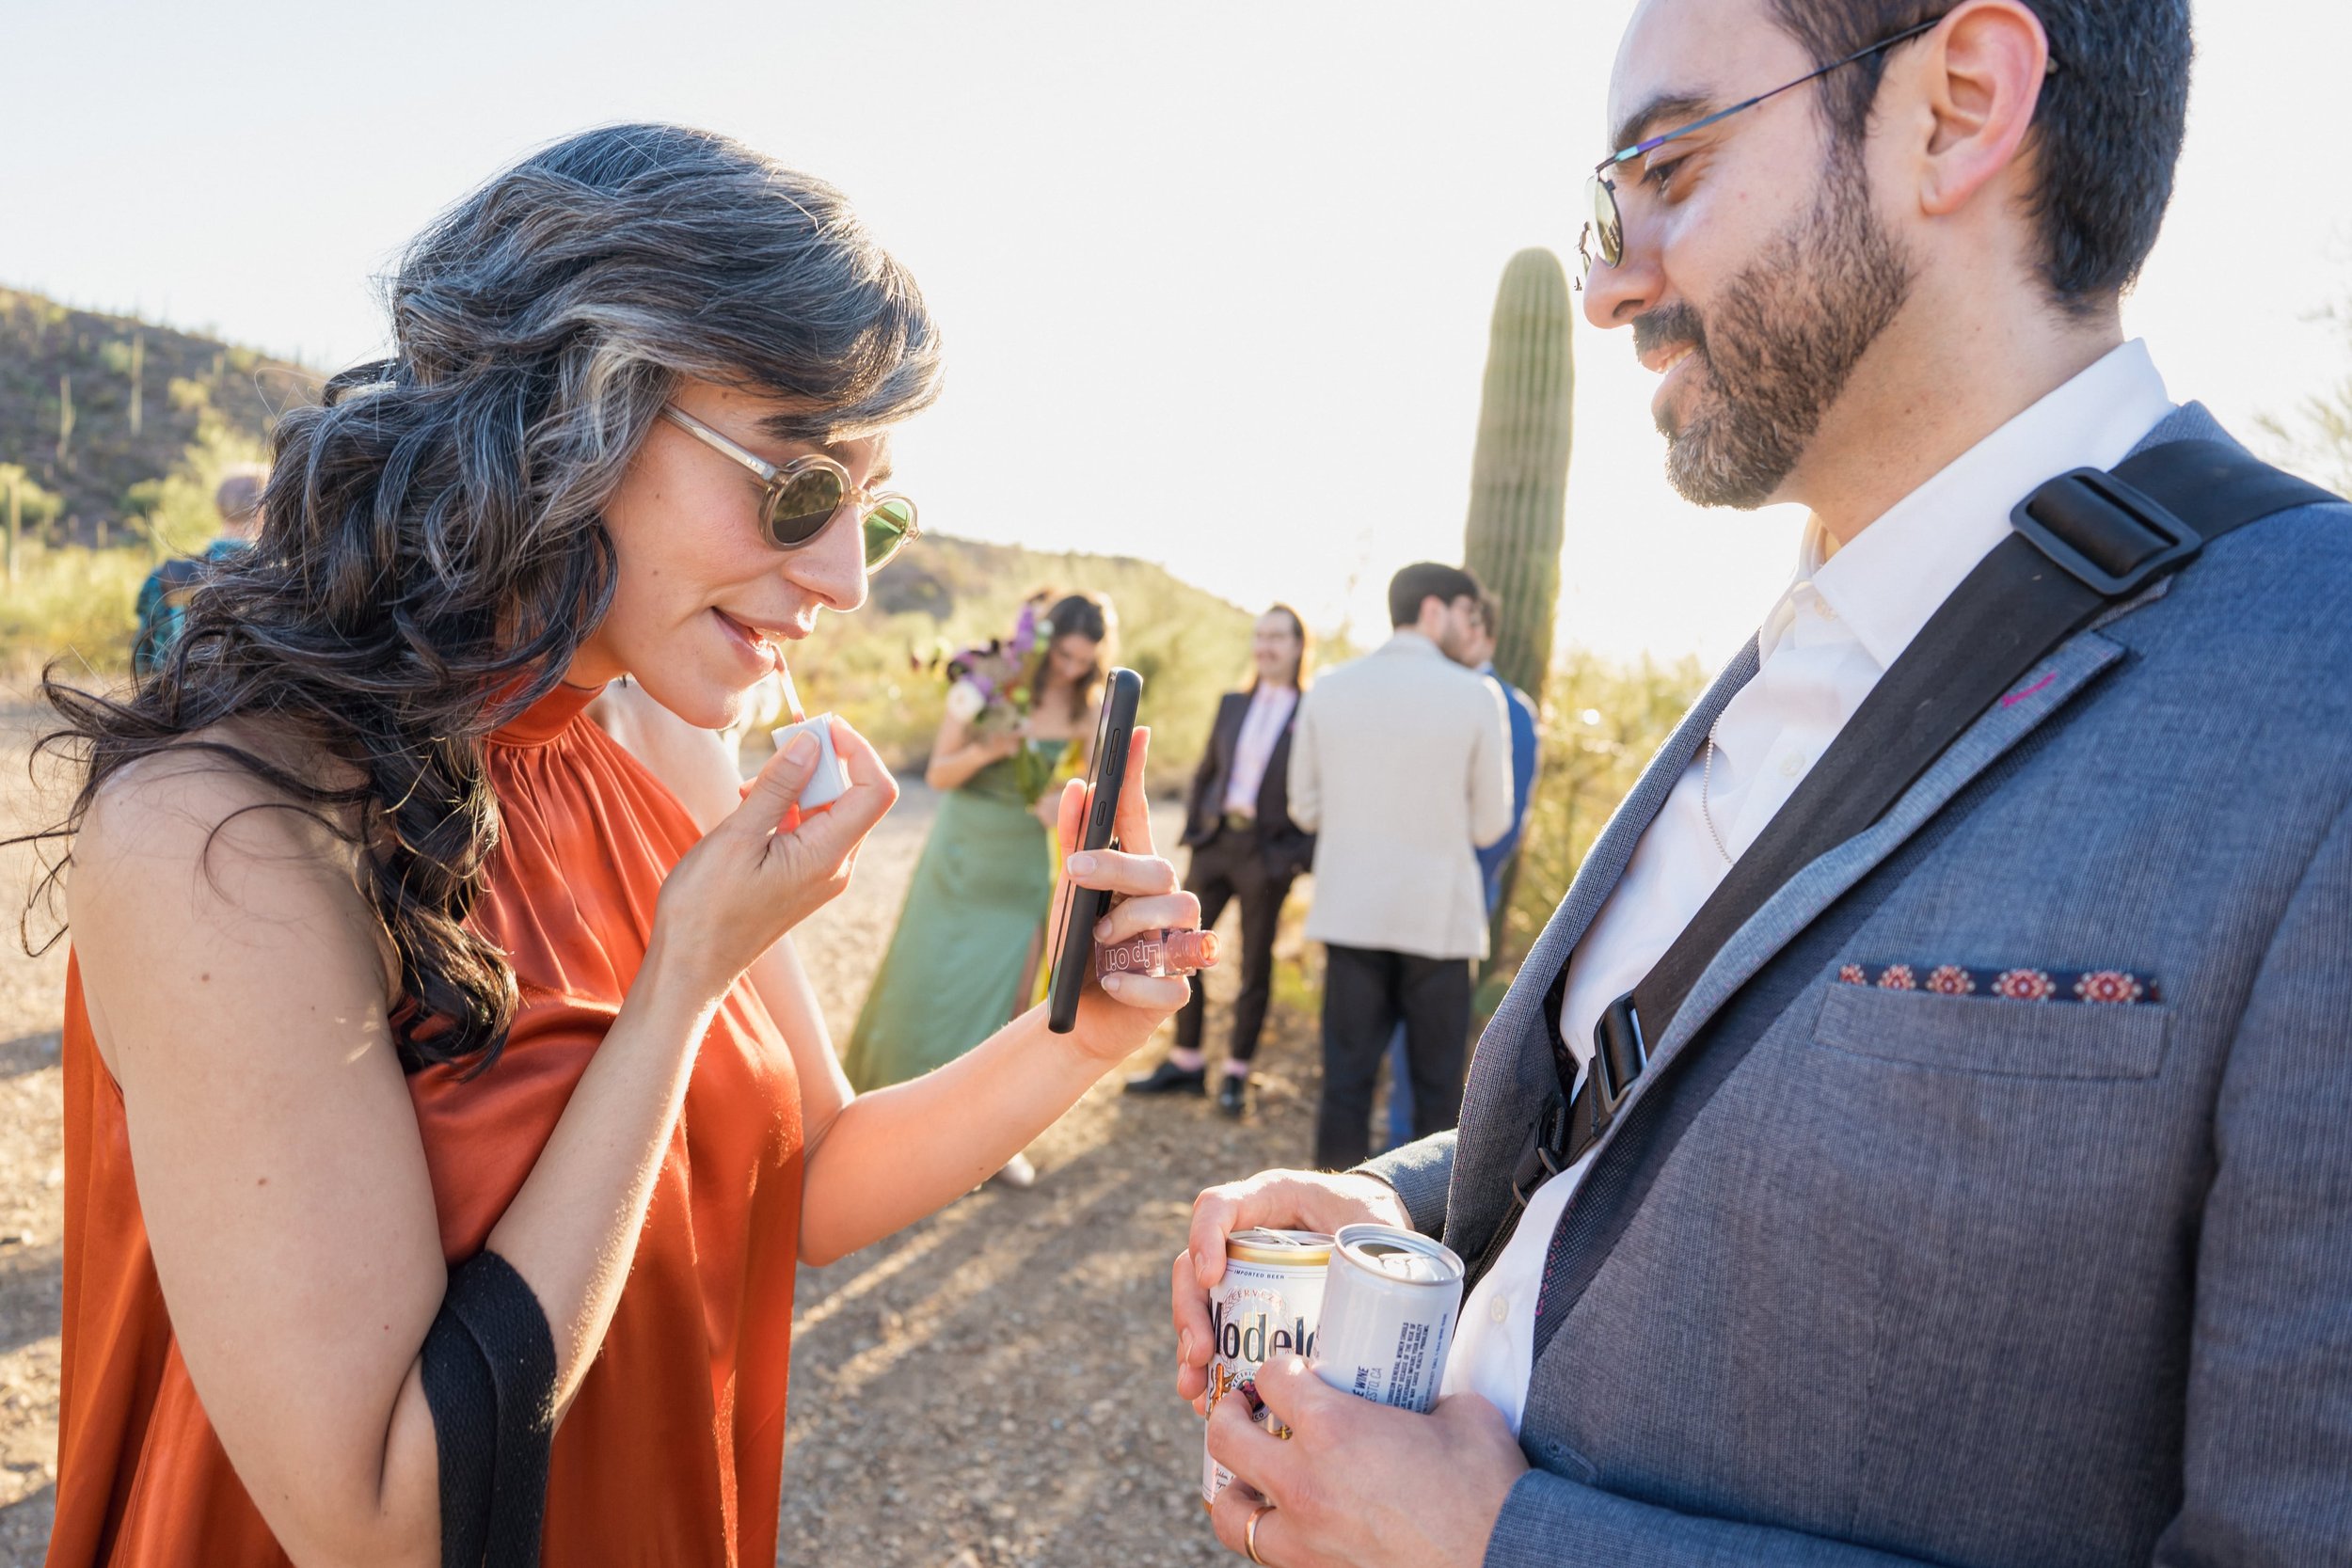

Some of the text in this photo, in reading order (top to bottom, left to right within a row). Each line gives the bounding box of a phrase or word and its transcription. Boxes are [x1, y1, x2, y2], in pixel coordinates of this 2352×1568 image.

[1104, 940, 1162, 972] Lip Oil
[1233, 1269, 1264, 1278] IMPORTED
[1396, 1340, 1405, 1359] WOMEN
[1355, 1365, 1369, 1389] WINE
[1370, 1368, 1382, 1380] CA
